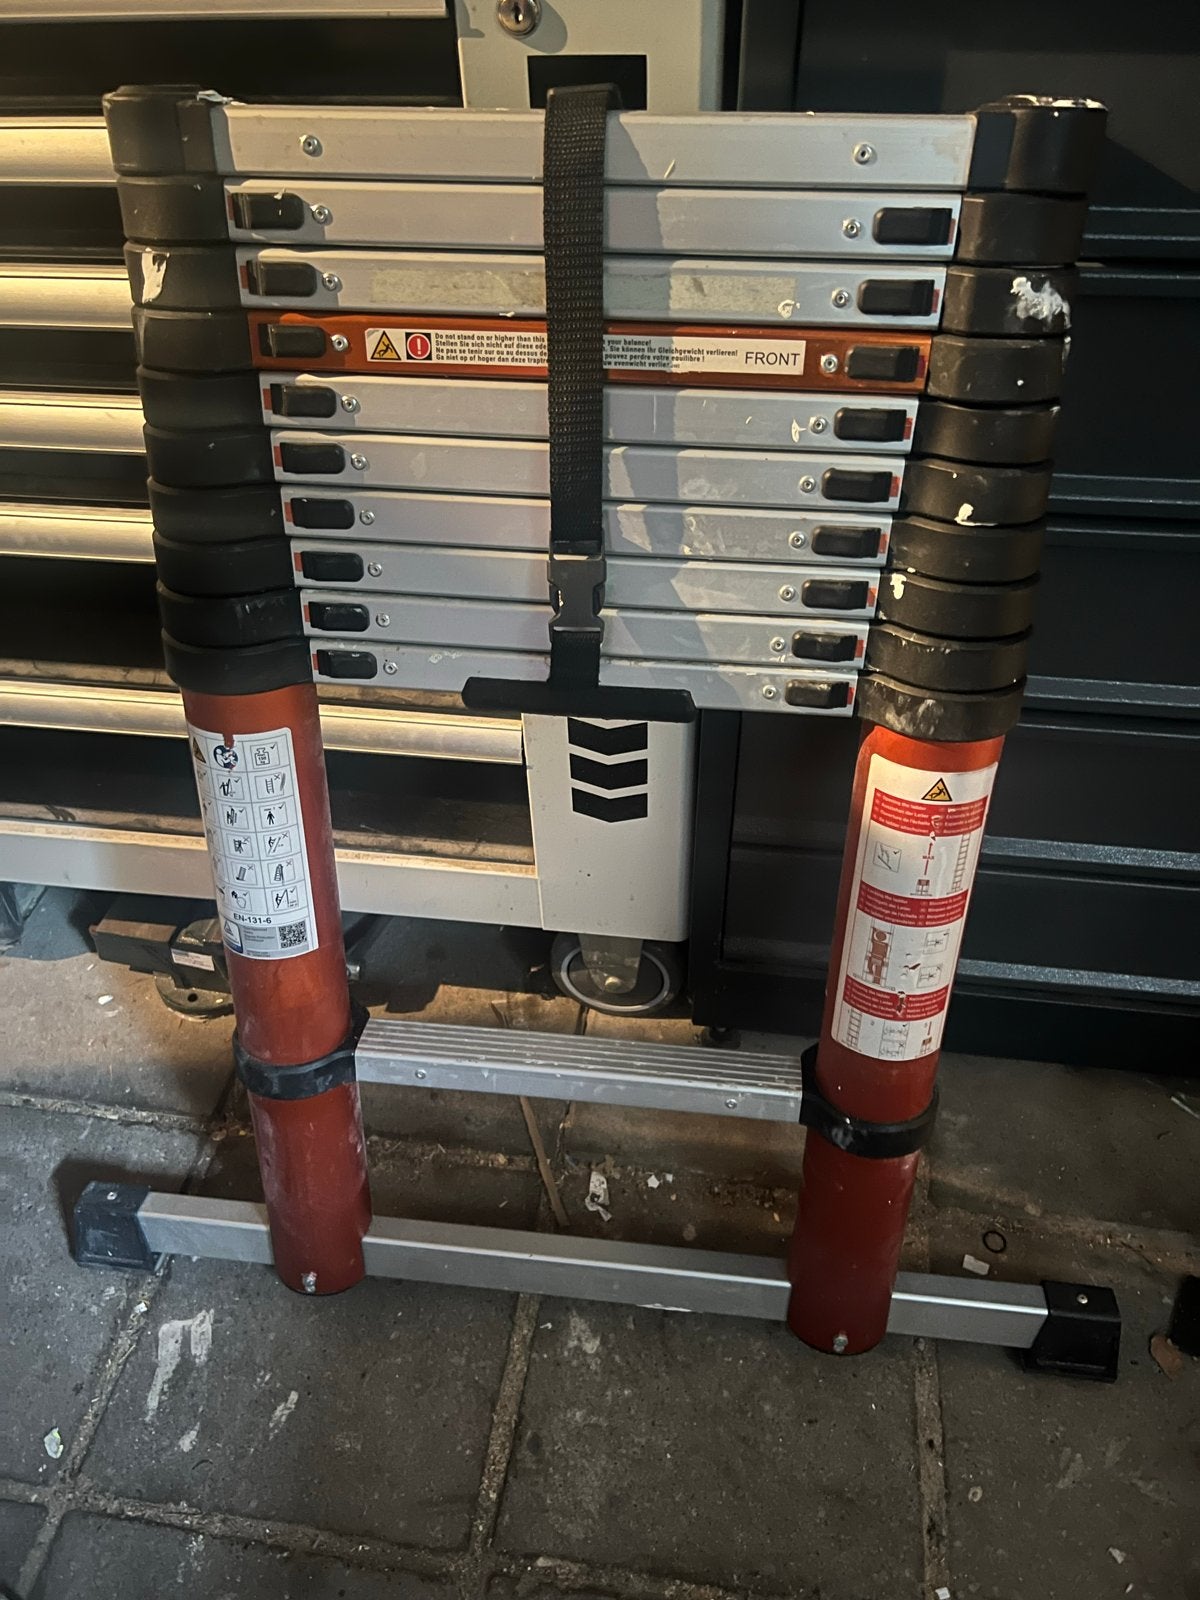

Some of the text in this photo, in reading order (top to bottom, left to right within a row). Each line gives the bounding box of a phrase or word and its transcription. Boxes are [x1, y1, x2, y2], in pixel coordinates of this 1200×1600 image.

[495, 334, 515, 342] higher
[658, 347, 704, 355] Gleichgewicht
[745, 352, 800, 366] FRONT
[234, 913, 272, 924] EN-131-6
